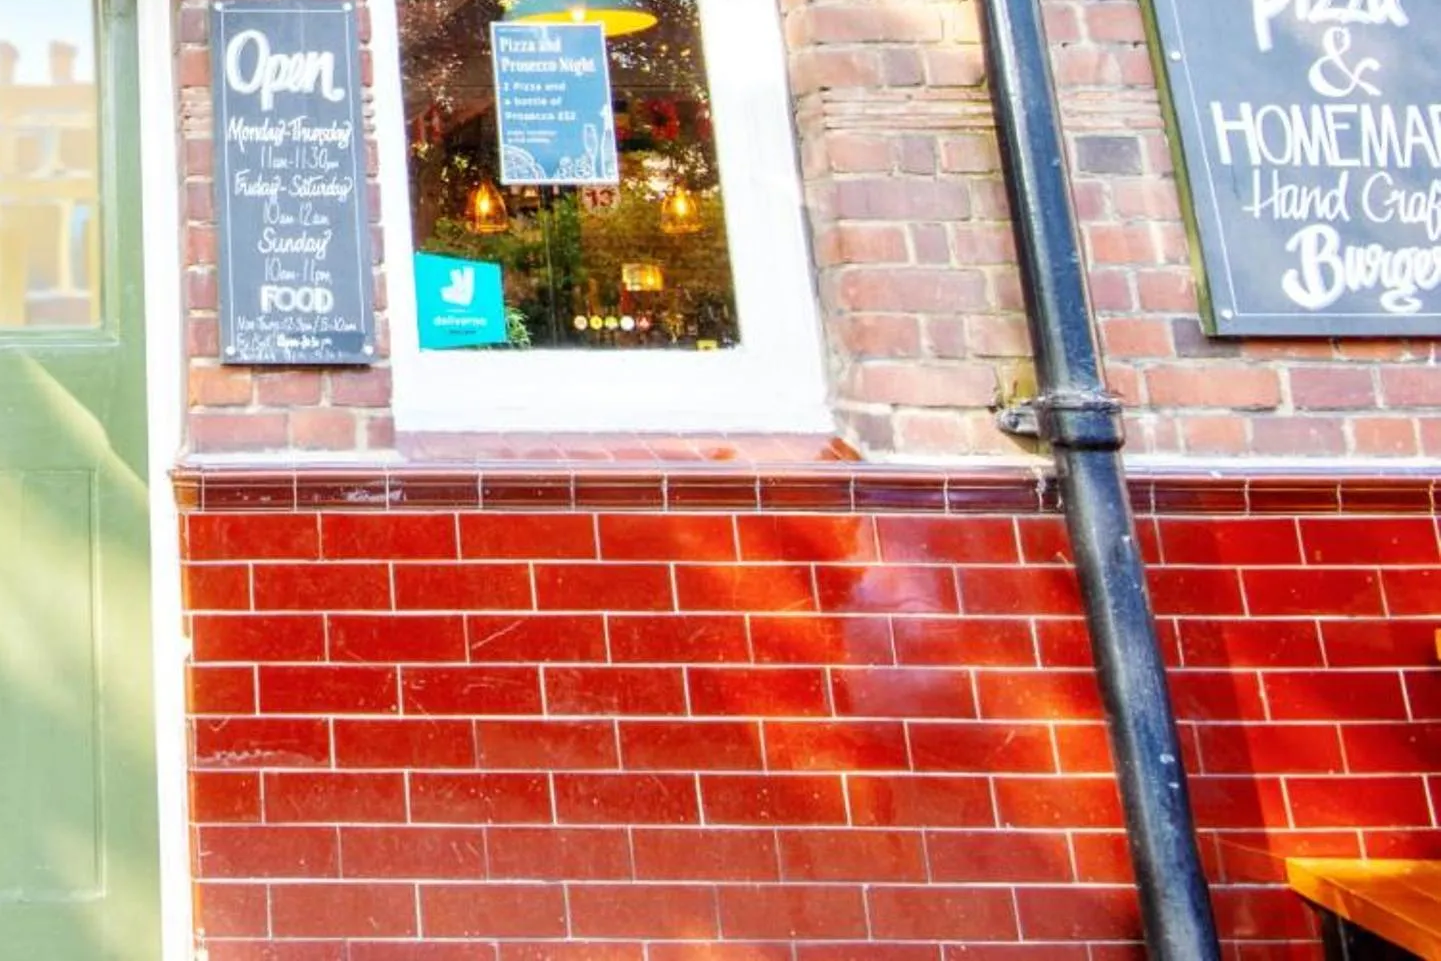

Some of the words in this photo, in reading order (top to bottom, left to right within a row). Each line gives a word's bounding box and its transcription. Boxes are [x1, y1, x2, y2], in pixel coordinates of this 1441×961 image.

[226, 30, 345, 111] Open
[501, 57, 557, 72] Prosecco
[1308, 26, 1383, 96] &
[1243, 170, 1350, 222] Hand
[258, 227, 332, 260] Sunday
[1282, 224, 1441, 313] Burge
[261, 286, 333, 314] FOOD
